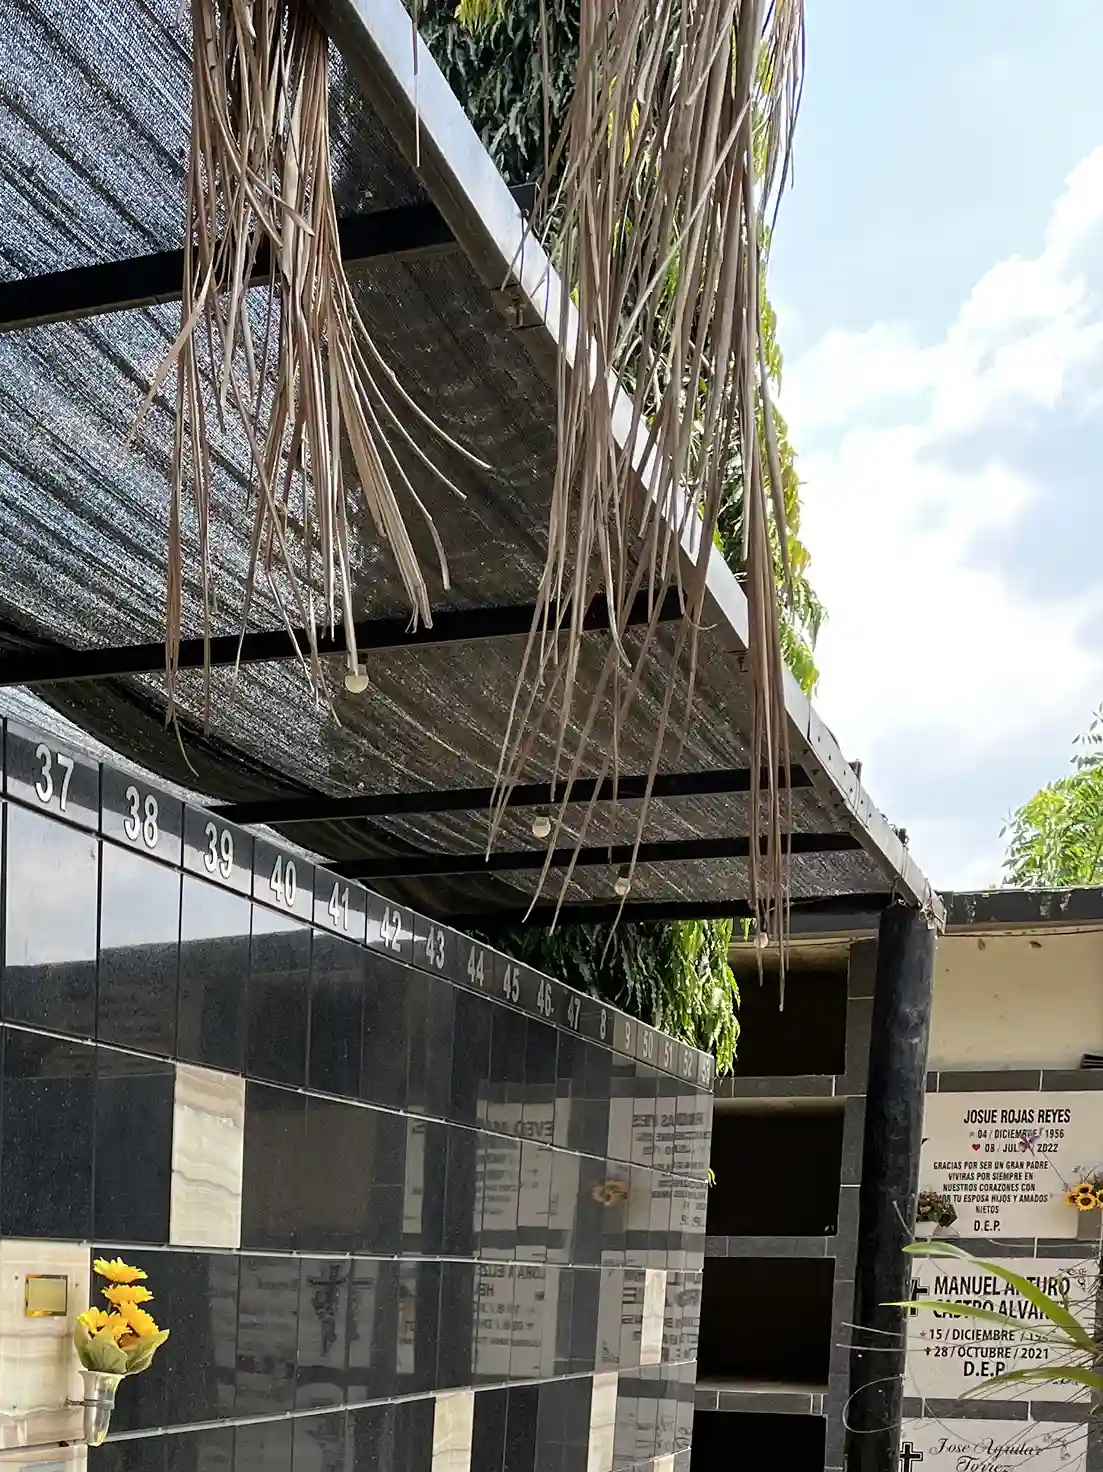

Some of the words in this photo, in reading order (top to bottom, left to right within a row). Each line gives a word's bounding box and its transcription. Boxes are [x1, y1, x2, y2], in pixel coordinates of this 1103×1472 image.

[35, 743, 74, 812] 37
[123, 786, 158, 848] 38
[203, 822, 234, 879] 39
[269, 855, 297, 907] 40
[327, 882, 349, 930] 41
[379, 907, 402, 952] 42
[425, 926, 445, 969] 43
[467, 946, 484, 987] 44
[503, 964, 520, 1002] 45
[537, 980, 552, 1017] 46
[567, 996, 581, 1030] 47
[643, 1030, 654, 1058] 50
[664, 1040, 673, 1069] 51
[683, 1049, 693, 1077] 52
[964, 1109, 997, 1124] JOSUE
[1000, 1109, 1035, 1124] ROJAS
[1037, 1108, 1071, 1123] REYES
[977, 1129, 987, 1139] 04
[1045, 1129, 1065, 1139] 1956
[984, 1143, 995, 1153] 08
[1037, 1143, 1059, 1153] 2022
[933, 1161, 962, 1170] GRACIAS
[964, 1161, 978, 1170] POR
[979, 1161, 993, 1169] SER
[994, 1161, 1004, 1169] UN
[1005, 1161, 1024, 1169] GRAN
[1026, 1161, 1049, 1169] PADRE
[948, 1172, 975, 1181] VIVIRAS
[976, 1172, 991, 1181] POR
[992, 1172, 1023, 1181] SIEMPRE
[1024, 1172, 1034, 1180] EN
[942, 1183, 977, 1192] NUESTROS
[979, 1183, 1019, 1192] CORAZONES
[1021, 1183, 1036, 1192] CON
[953, 1194, 962, 1203] TU
[963, 1194, 989, 1203] ESPOSA
[991, 1194, 1011, 1203] HIJOS
[1012, 1194, 1017, 1203] Y
[1018, 1194, 1048, 1203] AMADOS
[975, 1205, 999, 1214] NIETOS
[973, 1220, 1001, 1232] D.E.P.
[934, 1276, 1001, 1295] MANUEL
[929, 1329, 942, 1340] 15
[952, 1329, 1015, 1341] DICIEMBRE
[934, 1346, 948, 1357] 28
[957, 1346, 1012, 1359] OCTUBRE
[1021, 1347, 1049, 1359] 2021
[929, 1437, 970, 1455] Jose
[973, 1437, 1042, 1459] Aguilar
[956, 1455, 1014, 1472] Torrez
